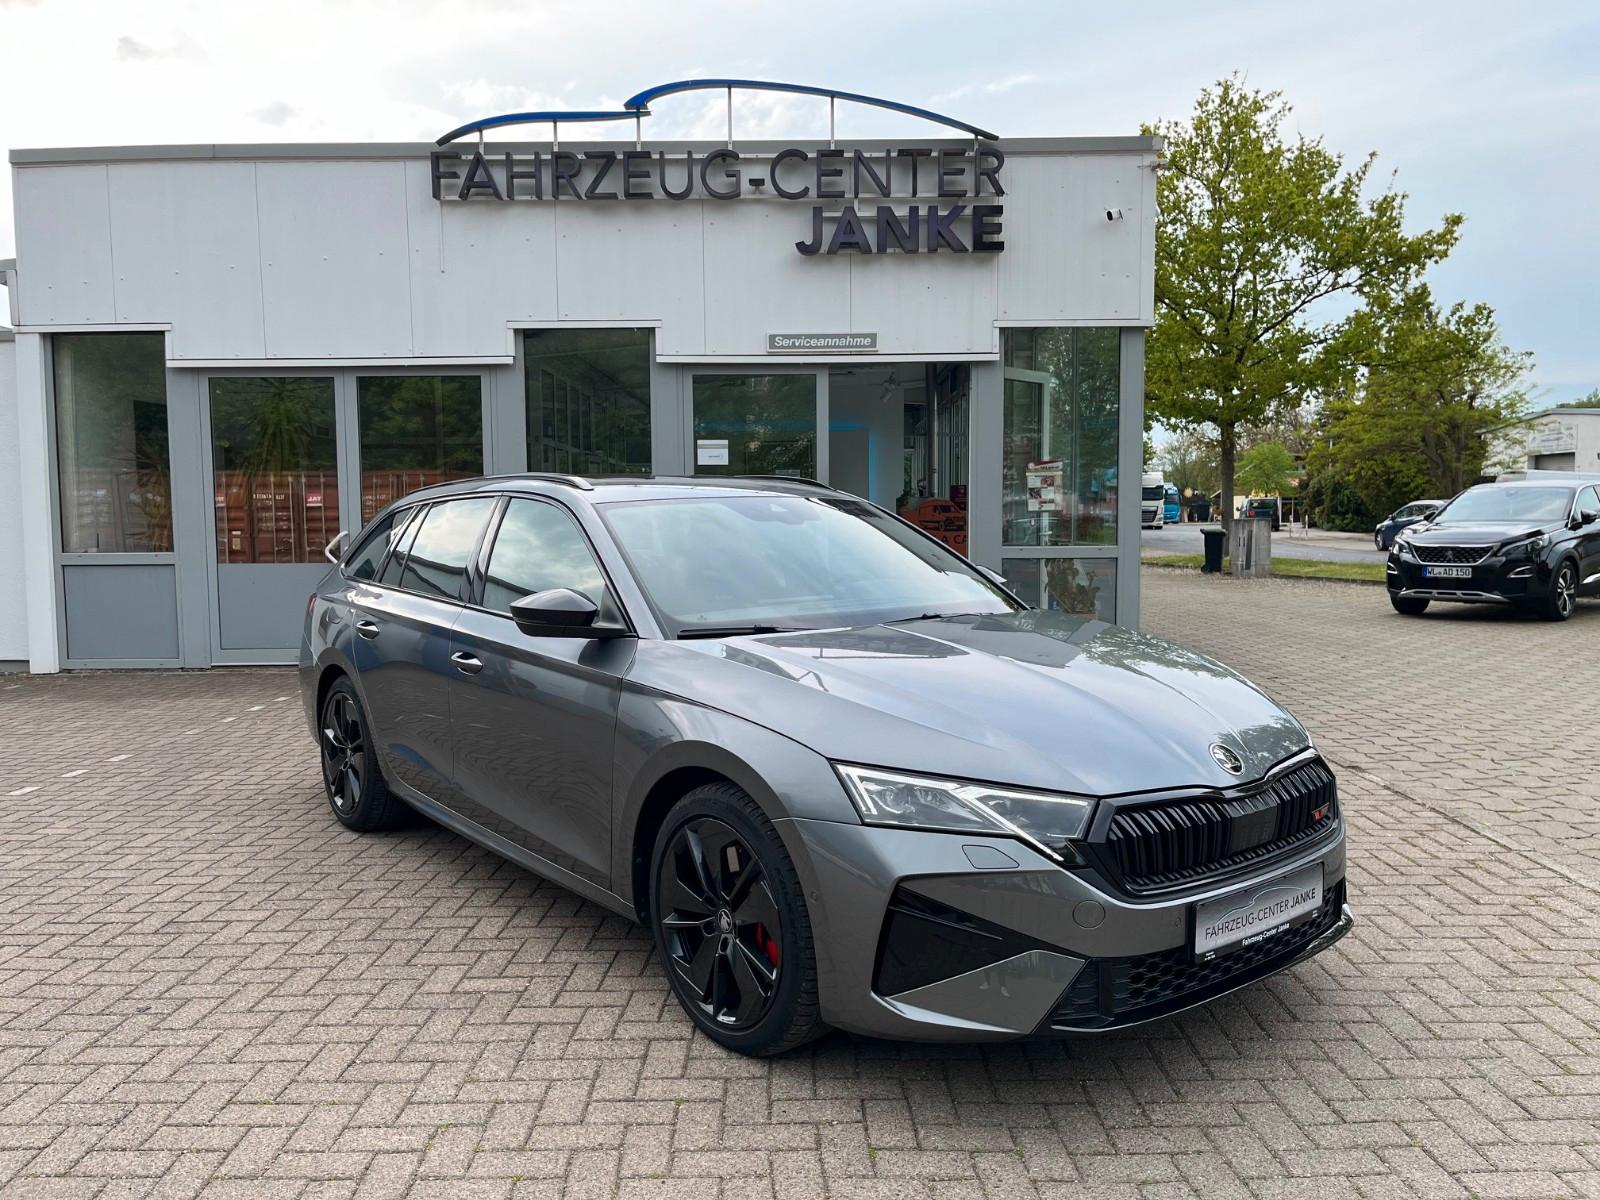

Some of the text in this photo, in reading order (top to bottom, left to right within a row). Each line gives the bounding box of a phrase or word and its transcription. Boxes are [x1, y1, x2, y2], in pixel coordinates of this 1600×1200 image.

[431, 148, 1005, 201] FAHRZEUG-CENTER
[795, 205, 1005, 255] JANKE
[774, 336, 872, 347] Serviceannahme
[1443, 568, 1454, 576] AD
[1455, 568, 1470, 577] 150
[1205, 887, 1316, 940] FAHRZEUG-CENTER JANKE
[1242, 928, 1278, 946] Fahrzeug-Center
